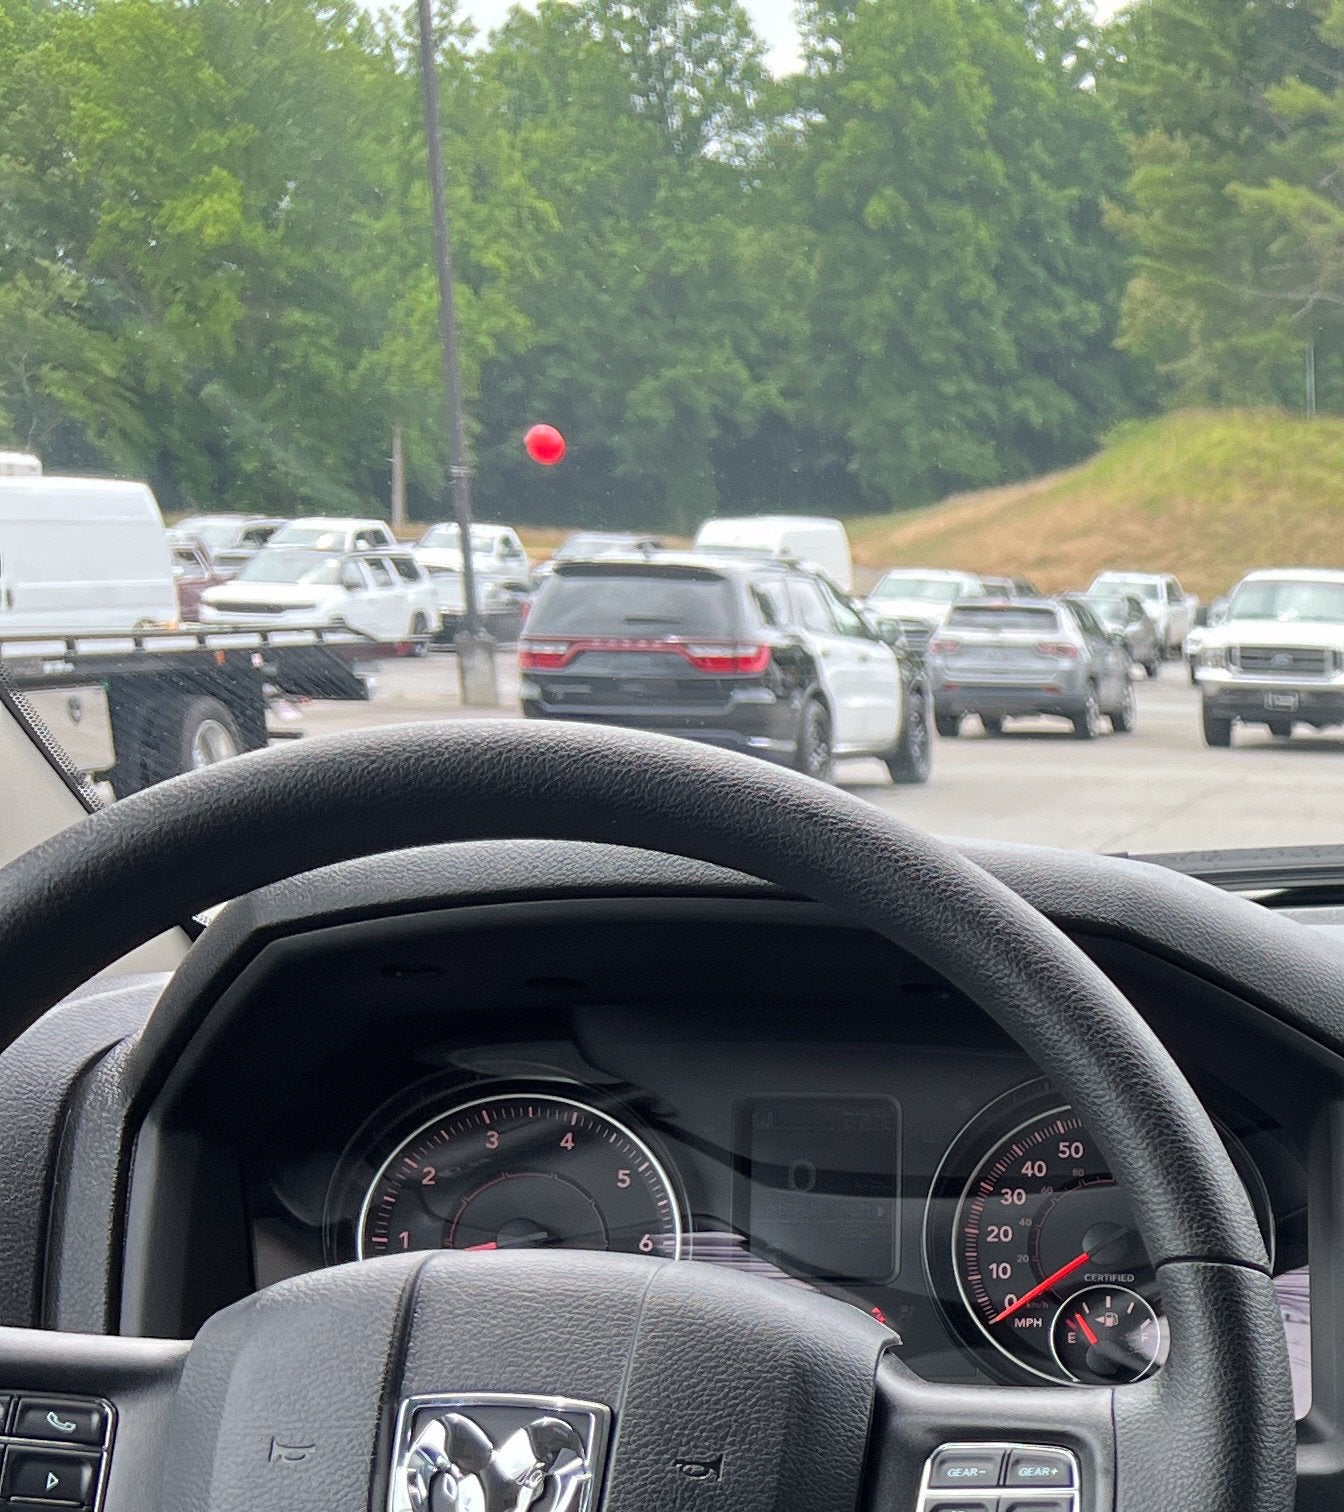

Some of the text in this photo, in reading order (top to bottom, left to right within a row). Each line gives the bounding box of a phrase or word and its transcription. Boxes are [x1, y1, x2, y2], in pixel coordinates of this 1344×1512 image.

[486, 1131, 500, 1149] 3
[560, 1132, 575, 1150] 4
[1058, 1142, 1084, 1158] 50
[421, 1167, 437, 1185] 2
[1021, 1161, 1047, 1177] 40
[617, 1169, 631, 1188] 5
[1000, 1189, 1026, 1205] 30
[399, 1231, 410, 1249] 1
[986, 1226, 1013, 1243] 20
[639, 1234, 654, 1252] 6
[988, 1263, 1012, 1279] 10
[1084, 1274, 1135, 1283] CERTIFIED
[1014, 1317, 1043, 1328] MPH
[1067, 1332, 1077, 1344] E
